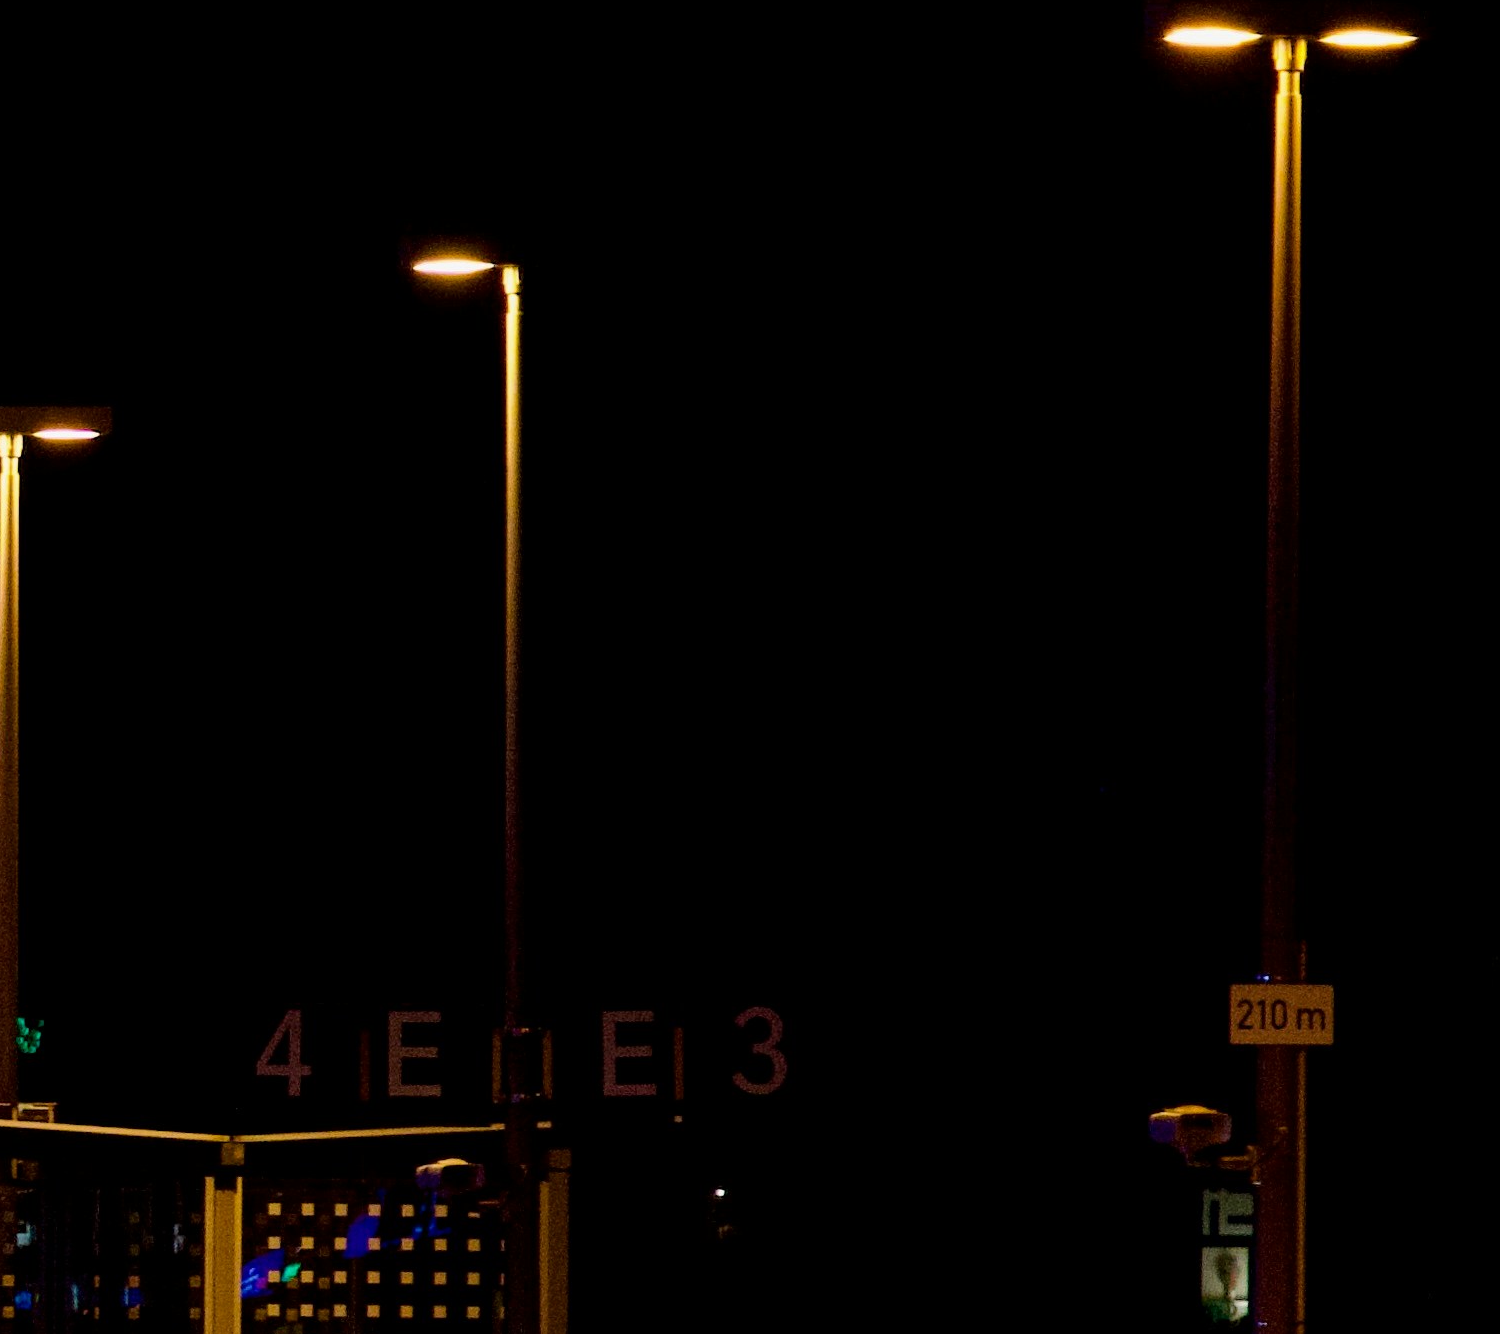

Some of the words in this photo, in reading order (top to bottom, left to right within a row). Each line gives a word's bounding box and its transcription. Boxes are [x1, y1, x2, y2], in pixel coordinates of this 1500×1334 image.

[1237, 999, 1288, 1030] 210
[1296, 1008, 1326, 1030] m
[256, 1010, 311, 1096] 4
[388, 1011, 441, 1097] E
[602, 1011, 656, 1097] E
[733, 1006, 787, 1095] 3
